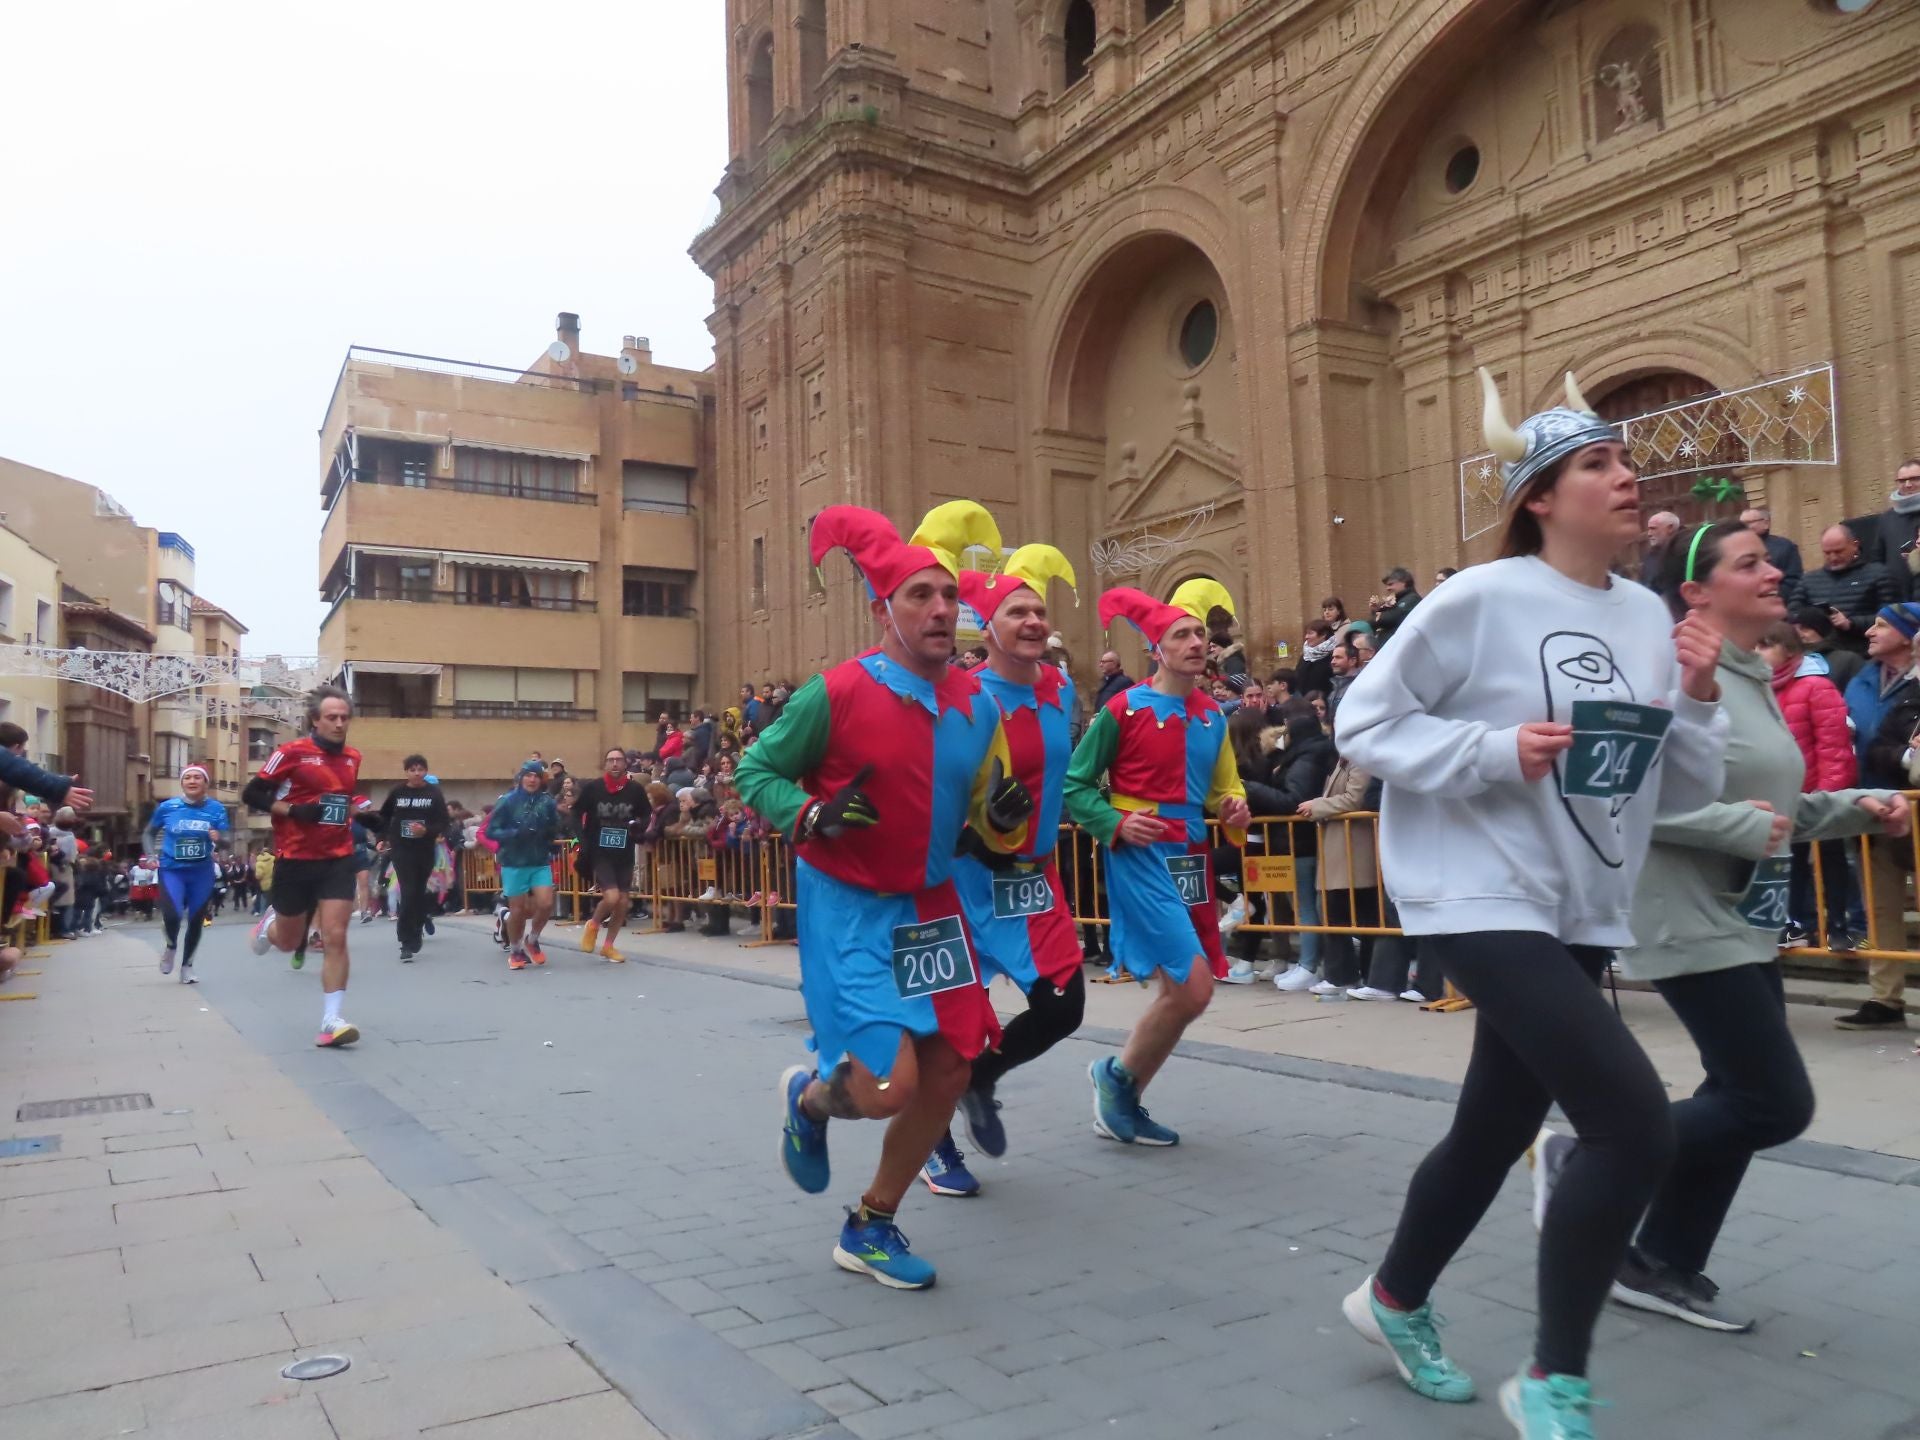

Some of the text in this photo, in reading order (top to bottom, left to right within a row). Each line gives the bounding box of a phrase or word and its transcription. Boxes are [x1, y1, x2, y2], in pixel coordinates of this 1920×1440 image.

[181, 845, 200, 857] 162
[605, 835, 621, 846] 163
[1005, 880, 1046, 910] 199
[903, 947, 955, 989] 200
